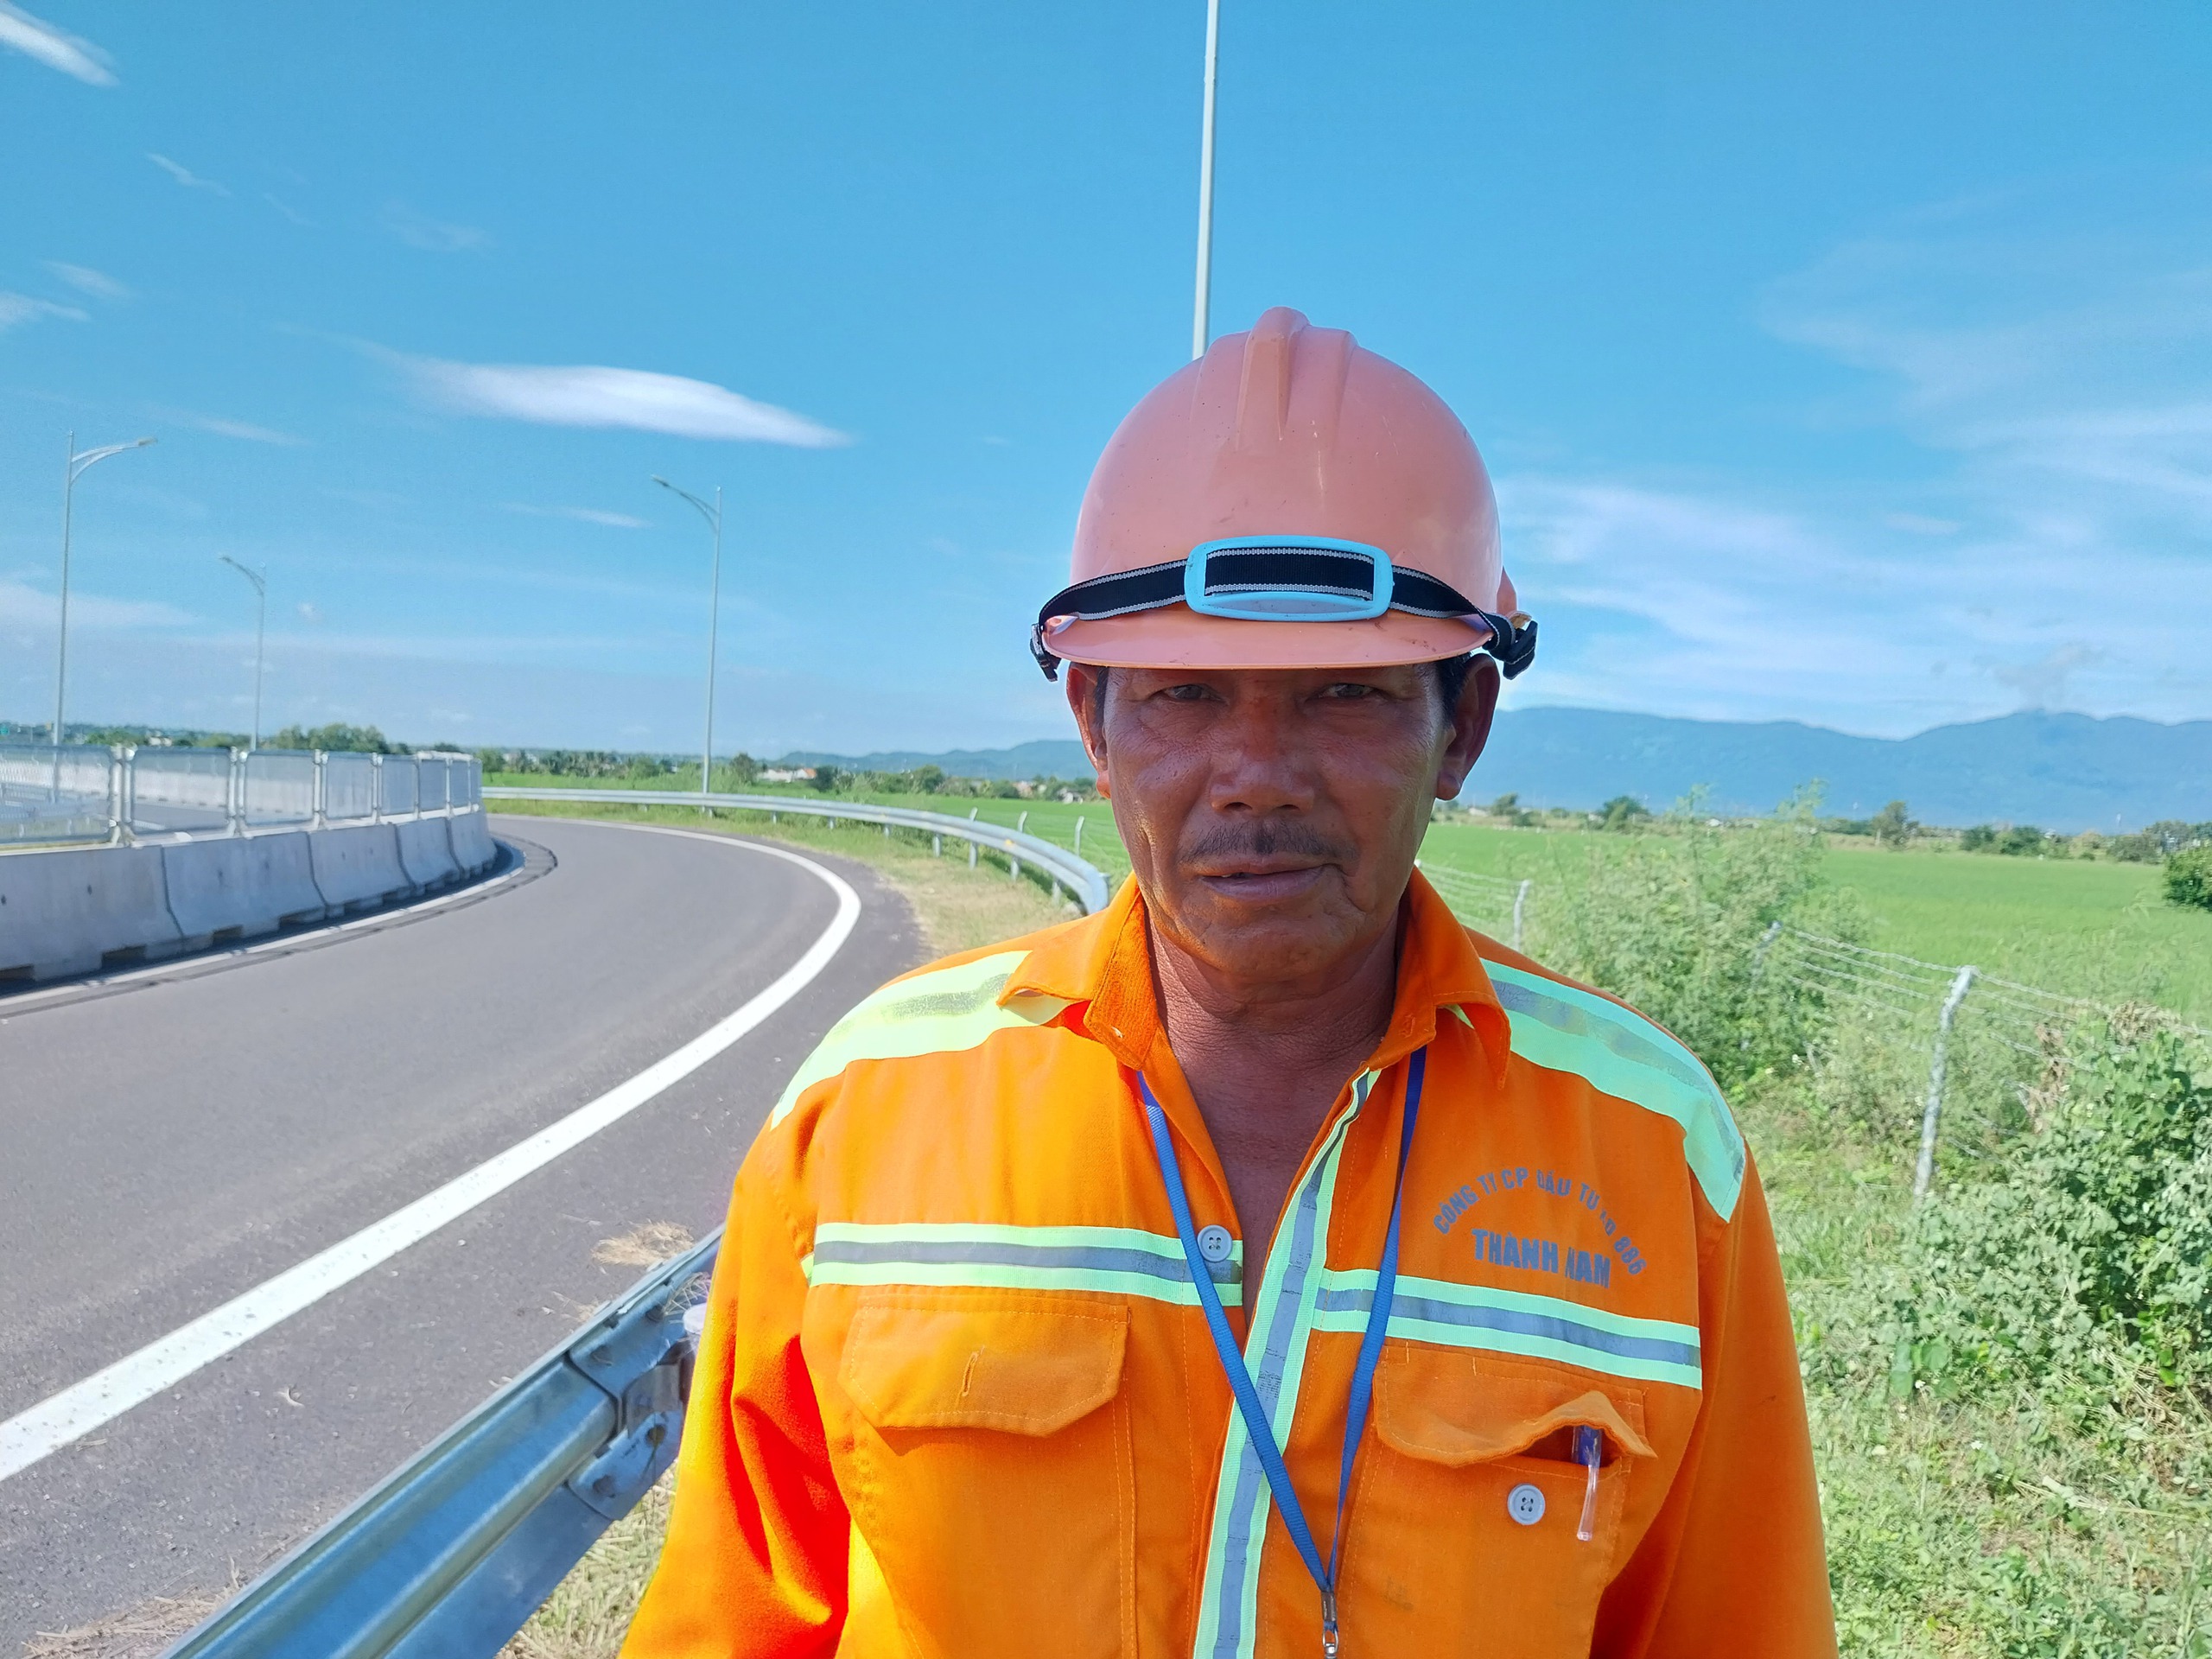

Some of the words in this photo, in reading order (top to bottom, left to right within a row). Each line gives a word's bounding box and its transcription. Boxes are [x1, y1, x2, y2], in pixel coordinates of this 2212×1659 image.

[1471, 1228, 1559, 1274] THÀNH
[1565, 1247, 1611, 1288] NAM
[1501, 1167, 1529, 1189] CP
[1614, 1236, 1647, 1275] 886
